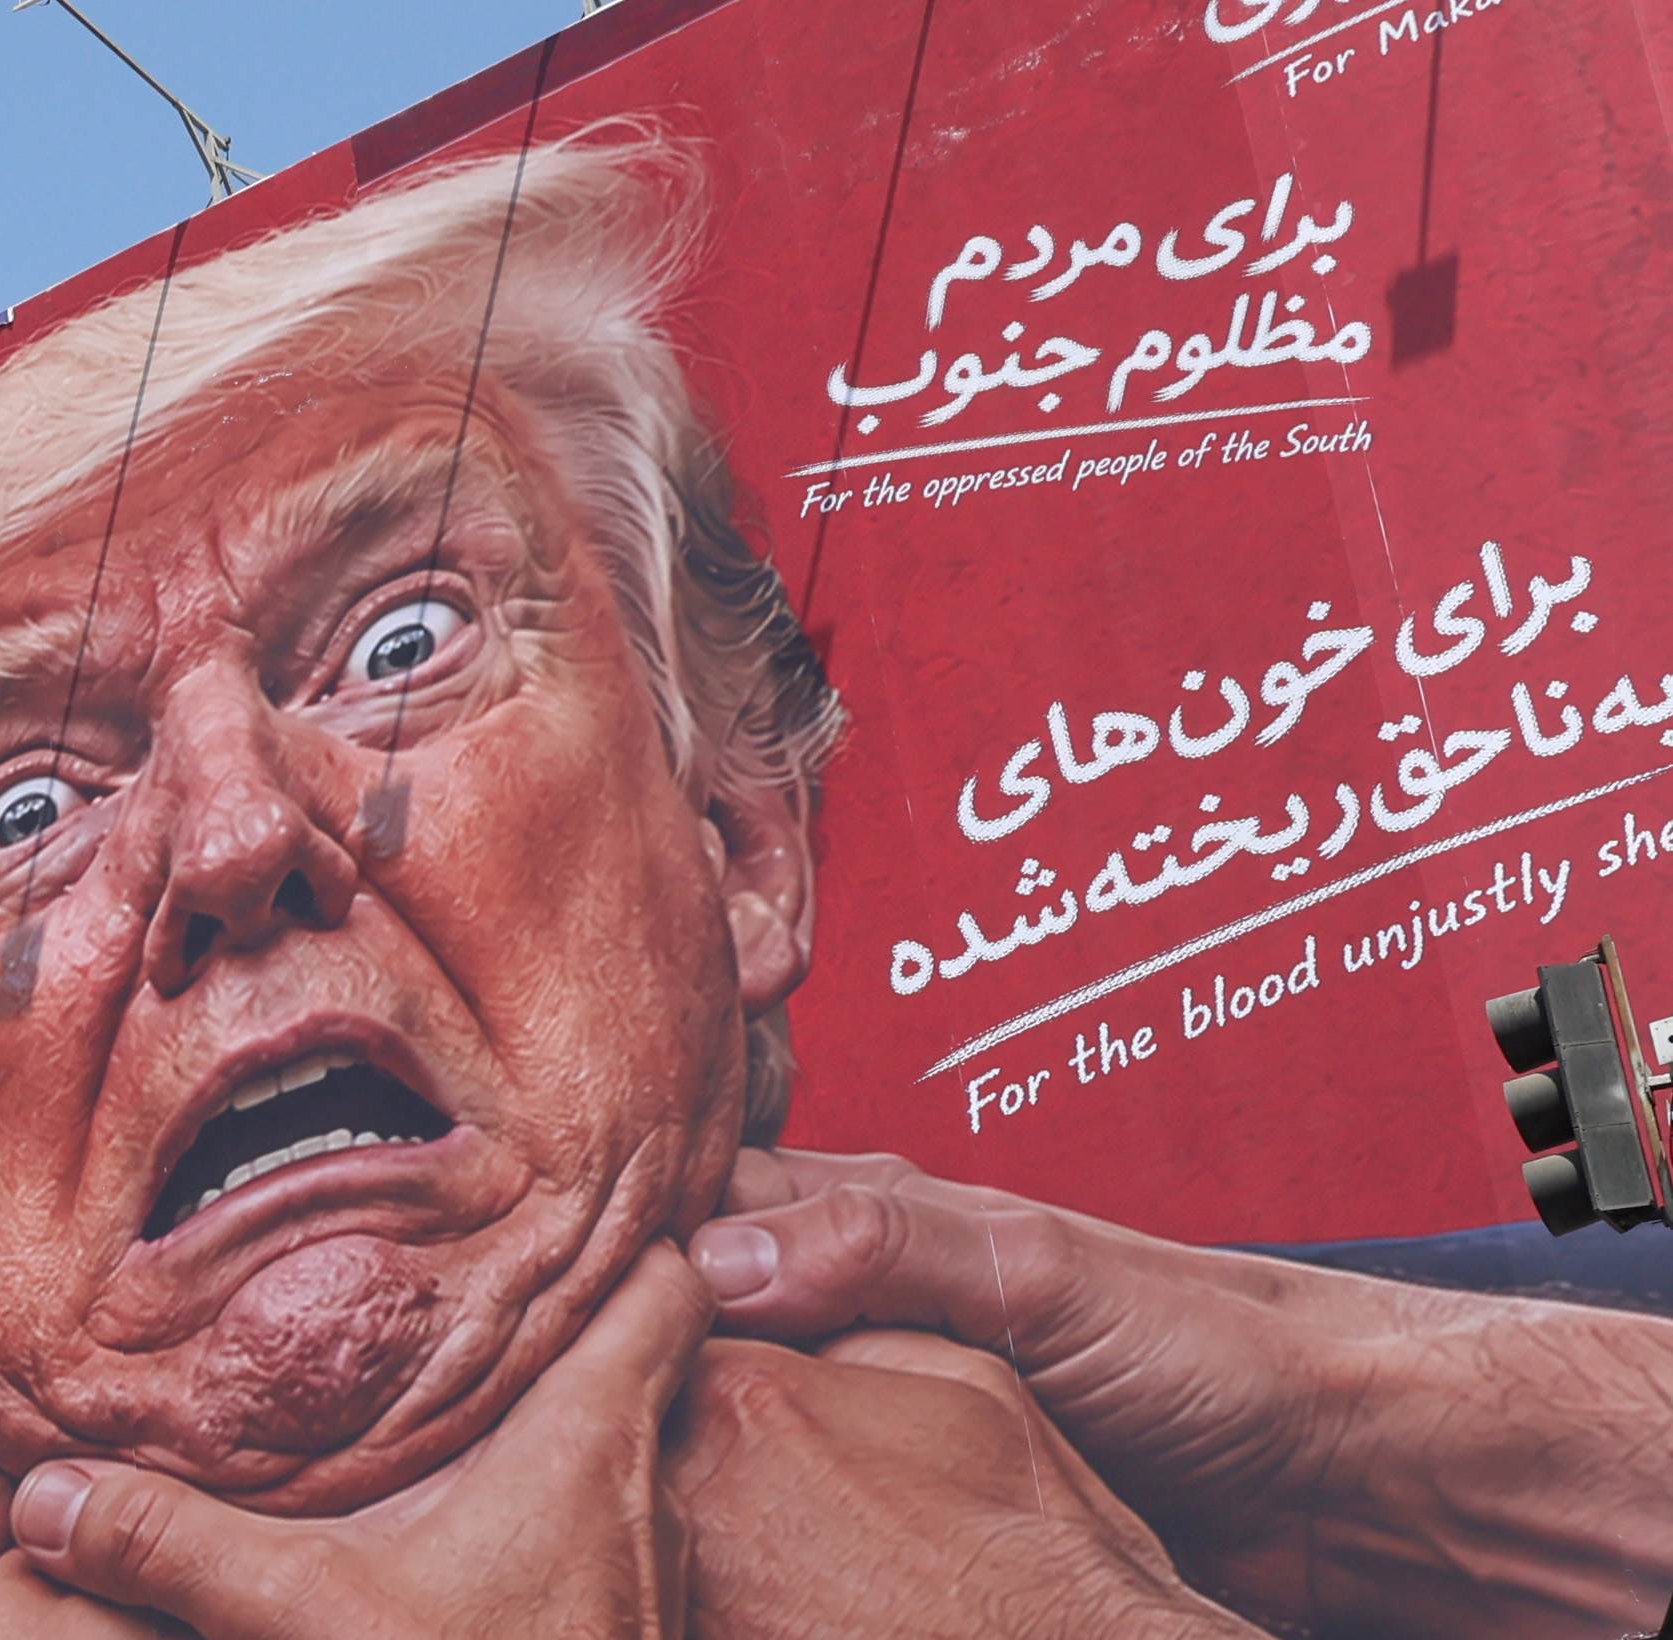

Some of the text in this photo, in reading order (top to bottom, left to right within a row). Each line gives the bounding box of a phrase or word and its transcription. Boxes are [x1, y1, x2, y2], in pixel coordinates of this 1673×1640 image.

[1284, 47, 1356, 97] For
[1378, 0, 1503, 55] Maka
[925, 171, 1355, 330] برای مردم
[827, 290, 1373, 434] مظلوم جنوب
[801, 414, 1371, 518] For the oppressed people of the South
[1394, 540, 1592, 676] برای
[965, 813, 1673, 1133] For the blood unjustly she
